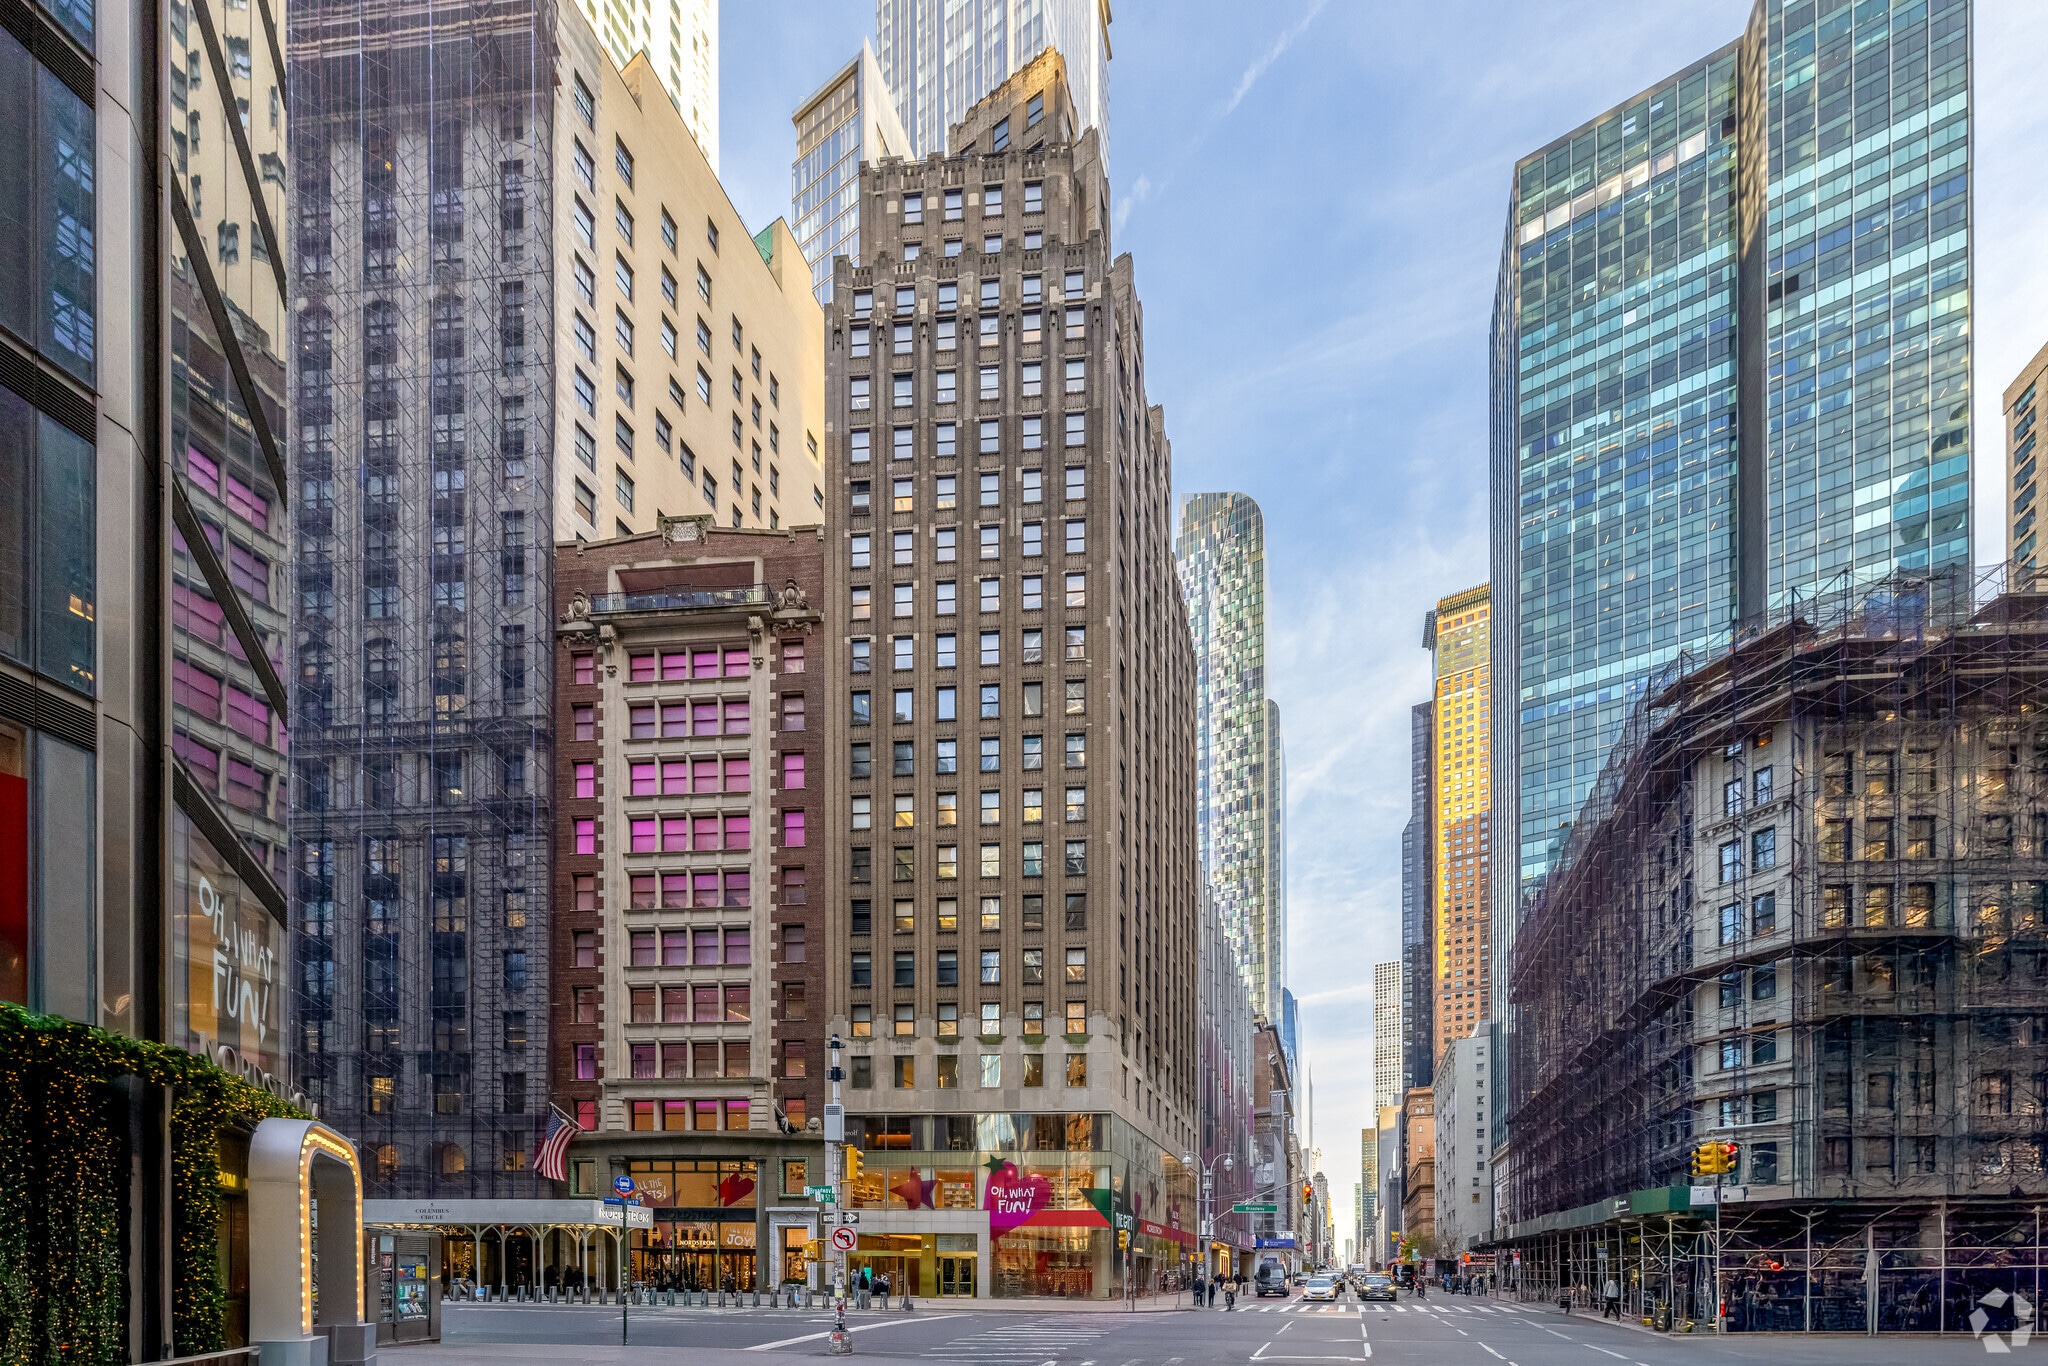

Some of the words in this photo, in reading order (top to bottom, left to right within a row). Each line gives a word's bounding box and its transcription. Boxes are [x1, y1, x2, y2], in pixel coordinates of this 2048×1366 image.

[199, 876, 230, 952] OH,
[233, 921, 274, 984] WHAT
[213, 948, 269, 1044] FUN!
[648, 1177, 662, 1189] THE
[635, 1186, 667, 1202] GFTS!
[991, 1186, 1007, 1199] OH,
[1009, 1187, 1035, 1198] WHAT
[998, 1197, 1032, 1214] FUN!
[599, 1207, 649, 1223] NORDTROM
[726, 1233, 756, 1249] JOY!
